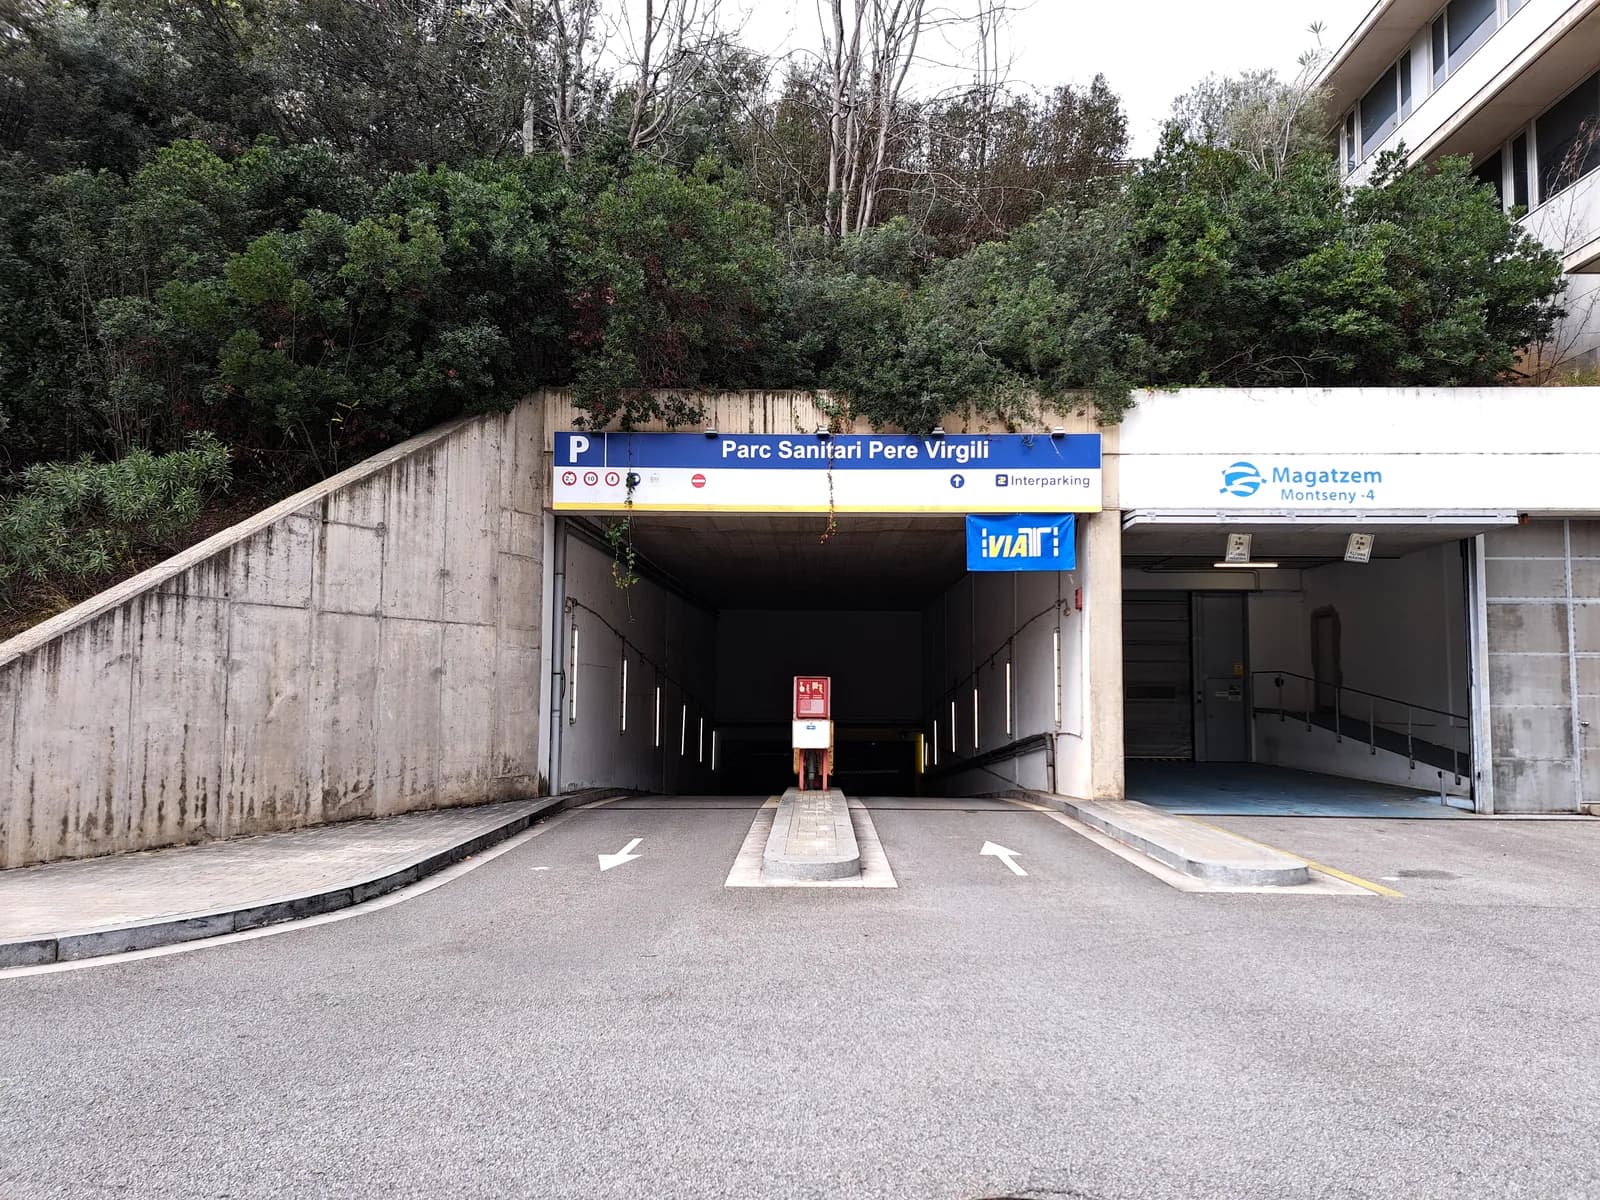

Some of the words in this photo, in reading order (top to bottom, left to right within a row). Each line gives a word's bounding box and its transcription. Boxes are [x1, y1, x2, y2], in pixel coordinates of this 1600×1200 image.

[569, 435, 590, 463] P
[722, 440, 771, 459] Parc
[778, 440, 861, 459] Sanitari
[869, 440, 918, 459] Pere
[925, 440, 989, 463] Virgili
[1011, 475, 1090, 488] Interparking
[1272, 467, 1382, 487] Magatzem
[1281, 488, 1356, 504] Montseny
[1361, 489, 1375, 500] -4
